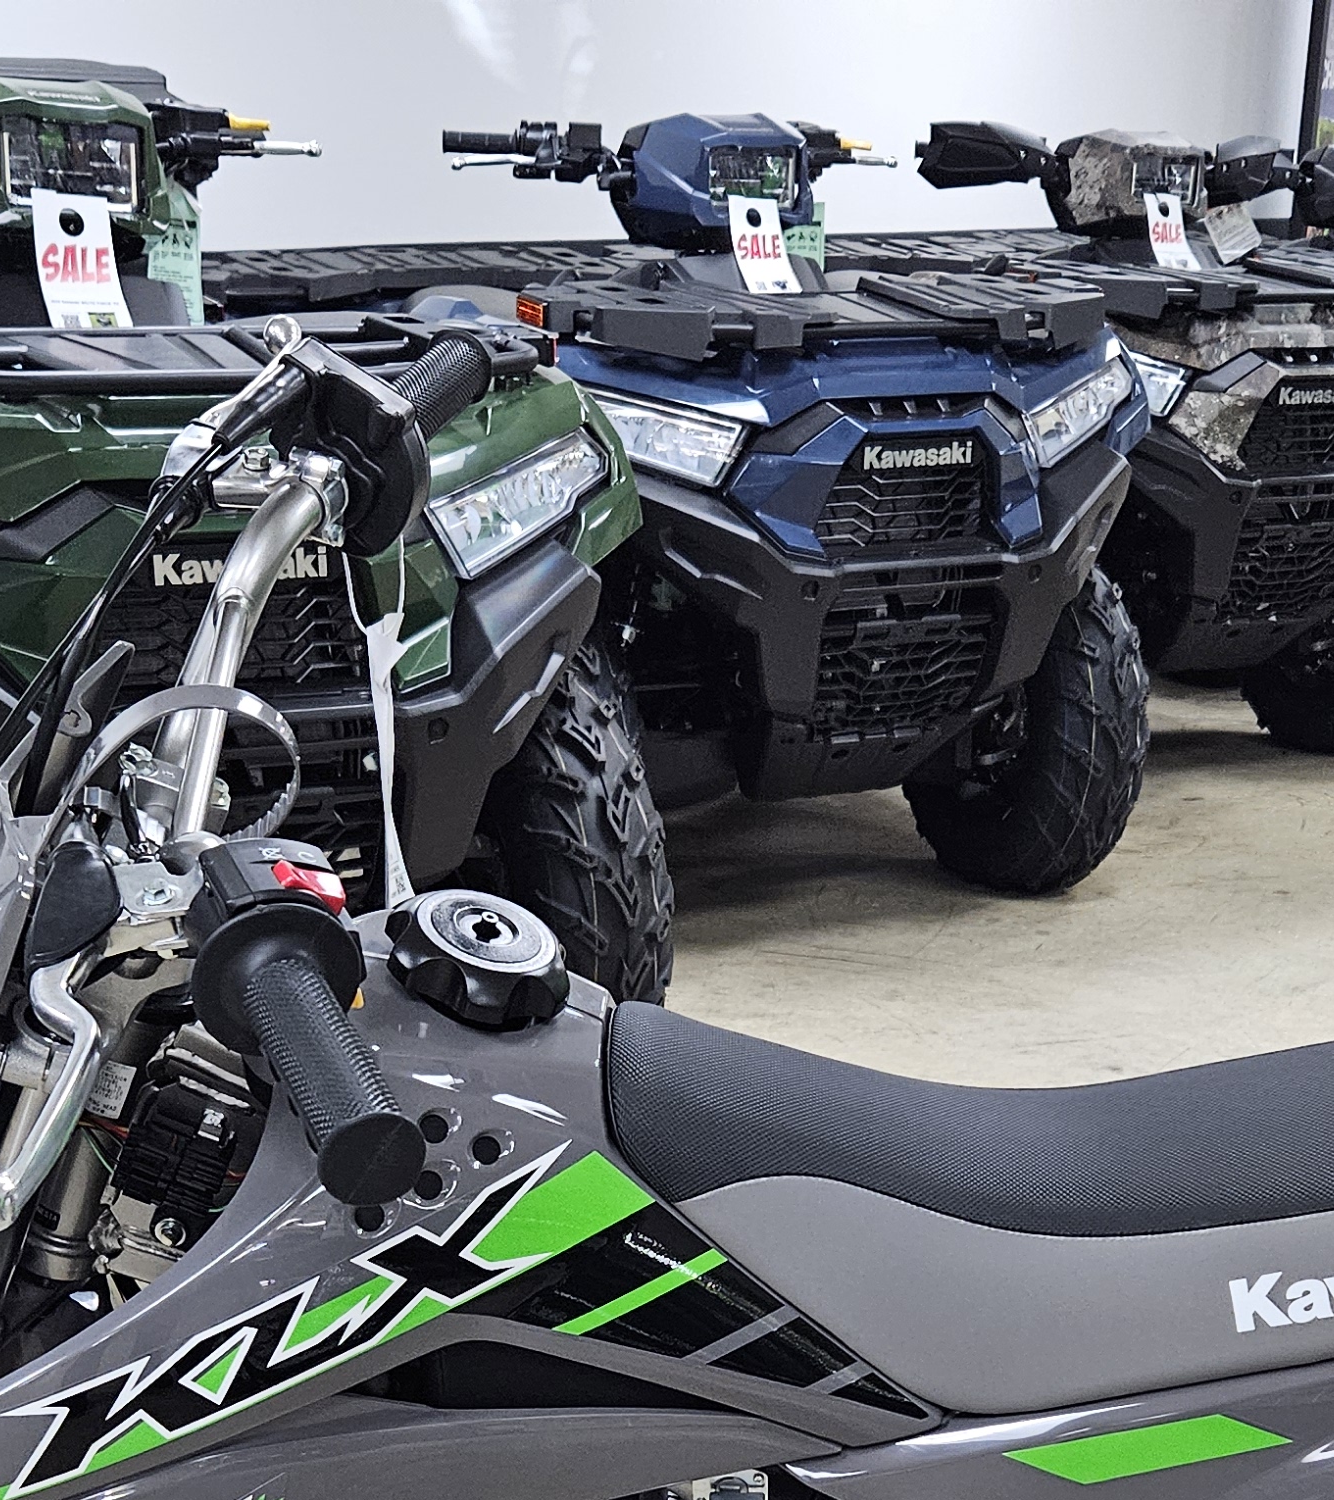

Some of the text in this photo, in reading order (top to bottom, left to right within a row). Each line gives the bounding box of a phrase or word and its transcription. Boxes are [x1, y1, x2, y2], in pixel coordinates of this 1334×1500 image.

[737, 233, 782, 260] SALE
[1152, 221, 1183, 244] SALE
[42, 242, 111, 285] SALE
[864, 441, 974, 471] Kawasaki
[153, 545, 328, 587] Kawaki
[2, 1140, 571, 1500] KLX
